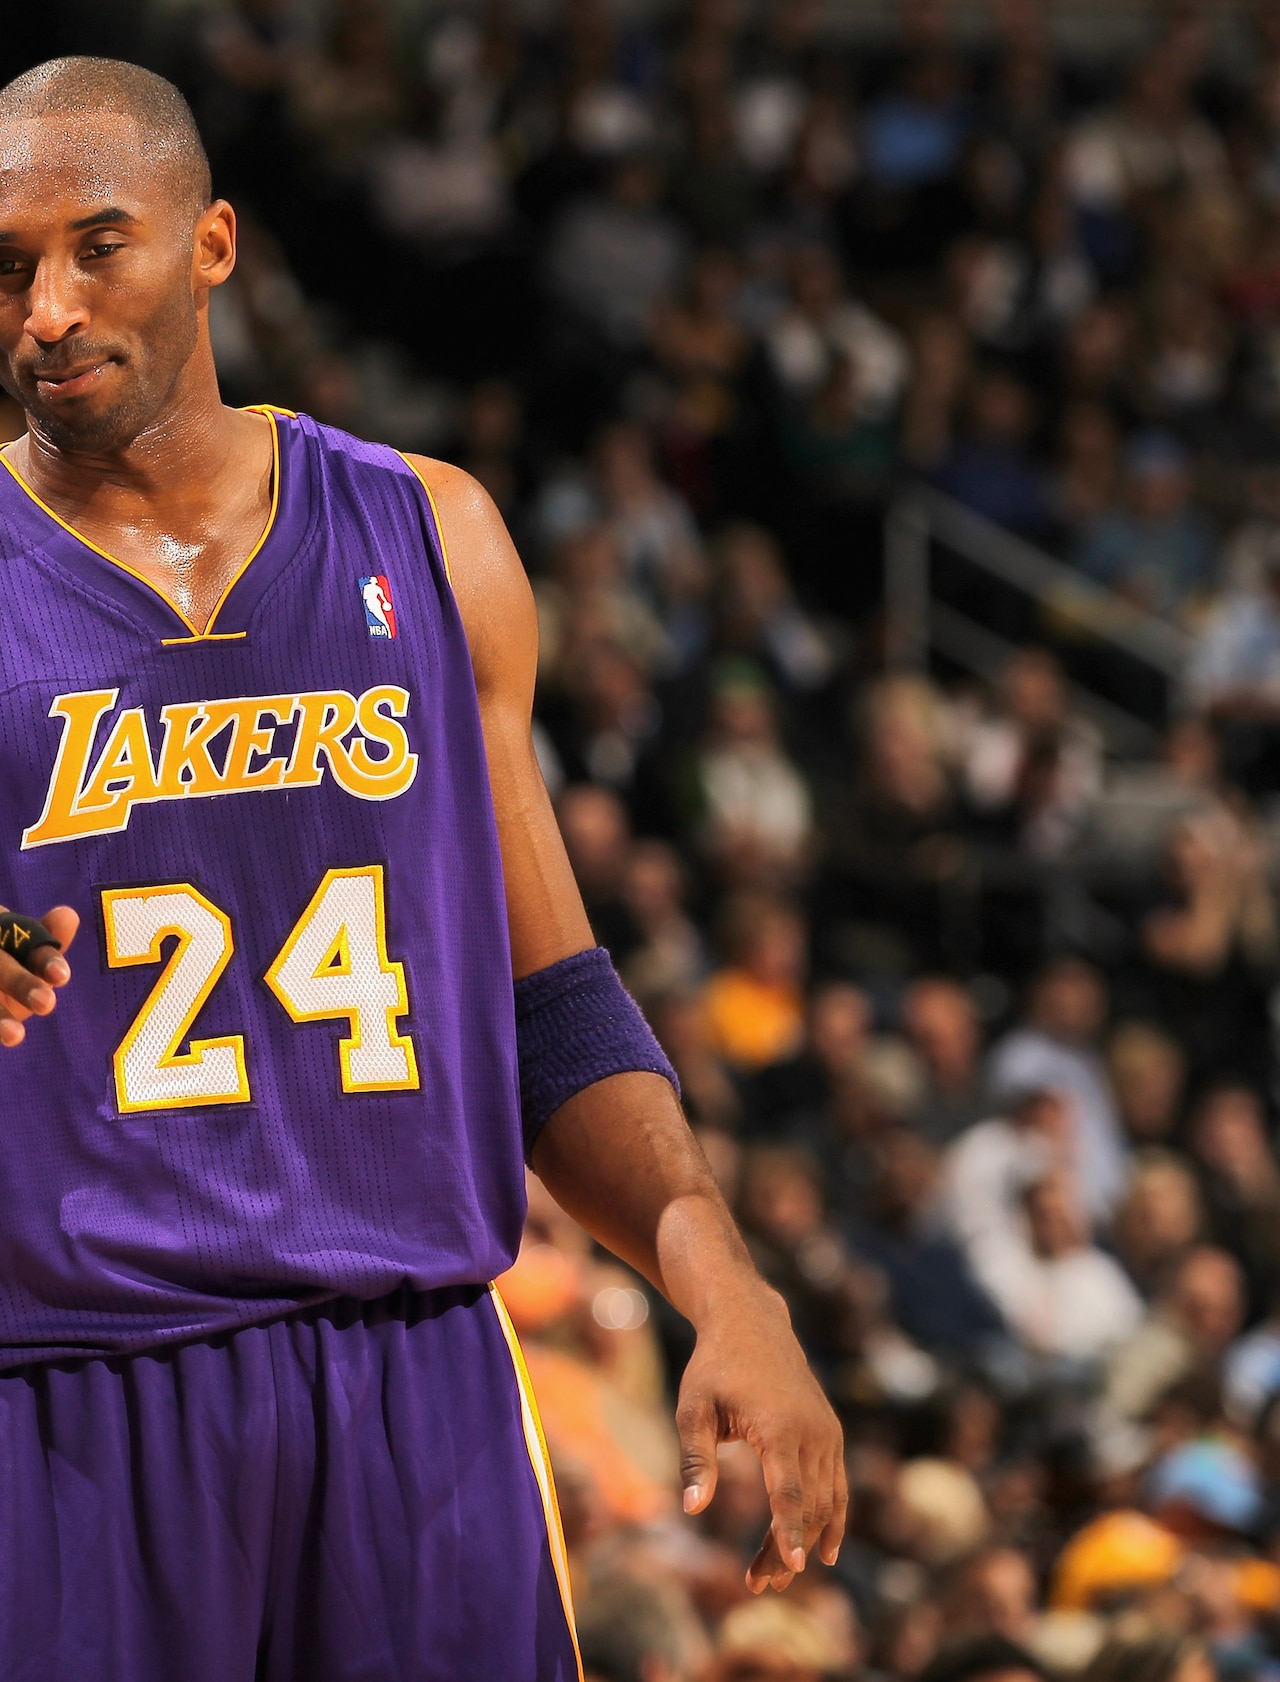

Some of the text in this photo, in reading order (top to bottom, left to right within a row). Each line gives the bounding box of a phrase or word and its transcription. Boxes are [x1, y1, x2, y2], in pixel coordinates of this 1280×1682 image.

[369, 625, 388, 636] NBA
[20, 685, 418, 849] LAKERS
[101, 865, 420, 1113] 24
